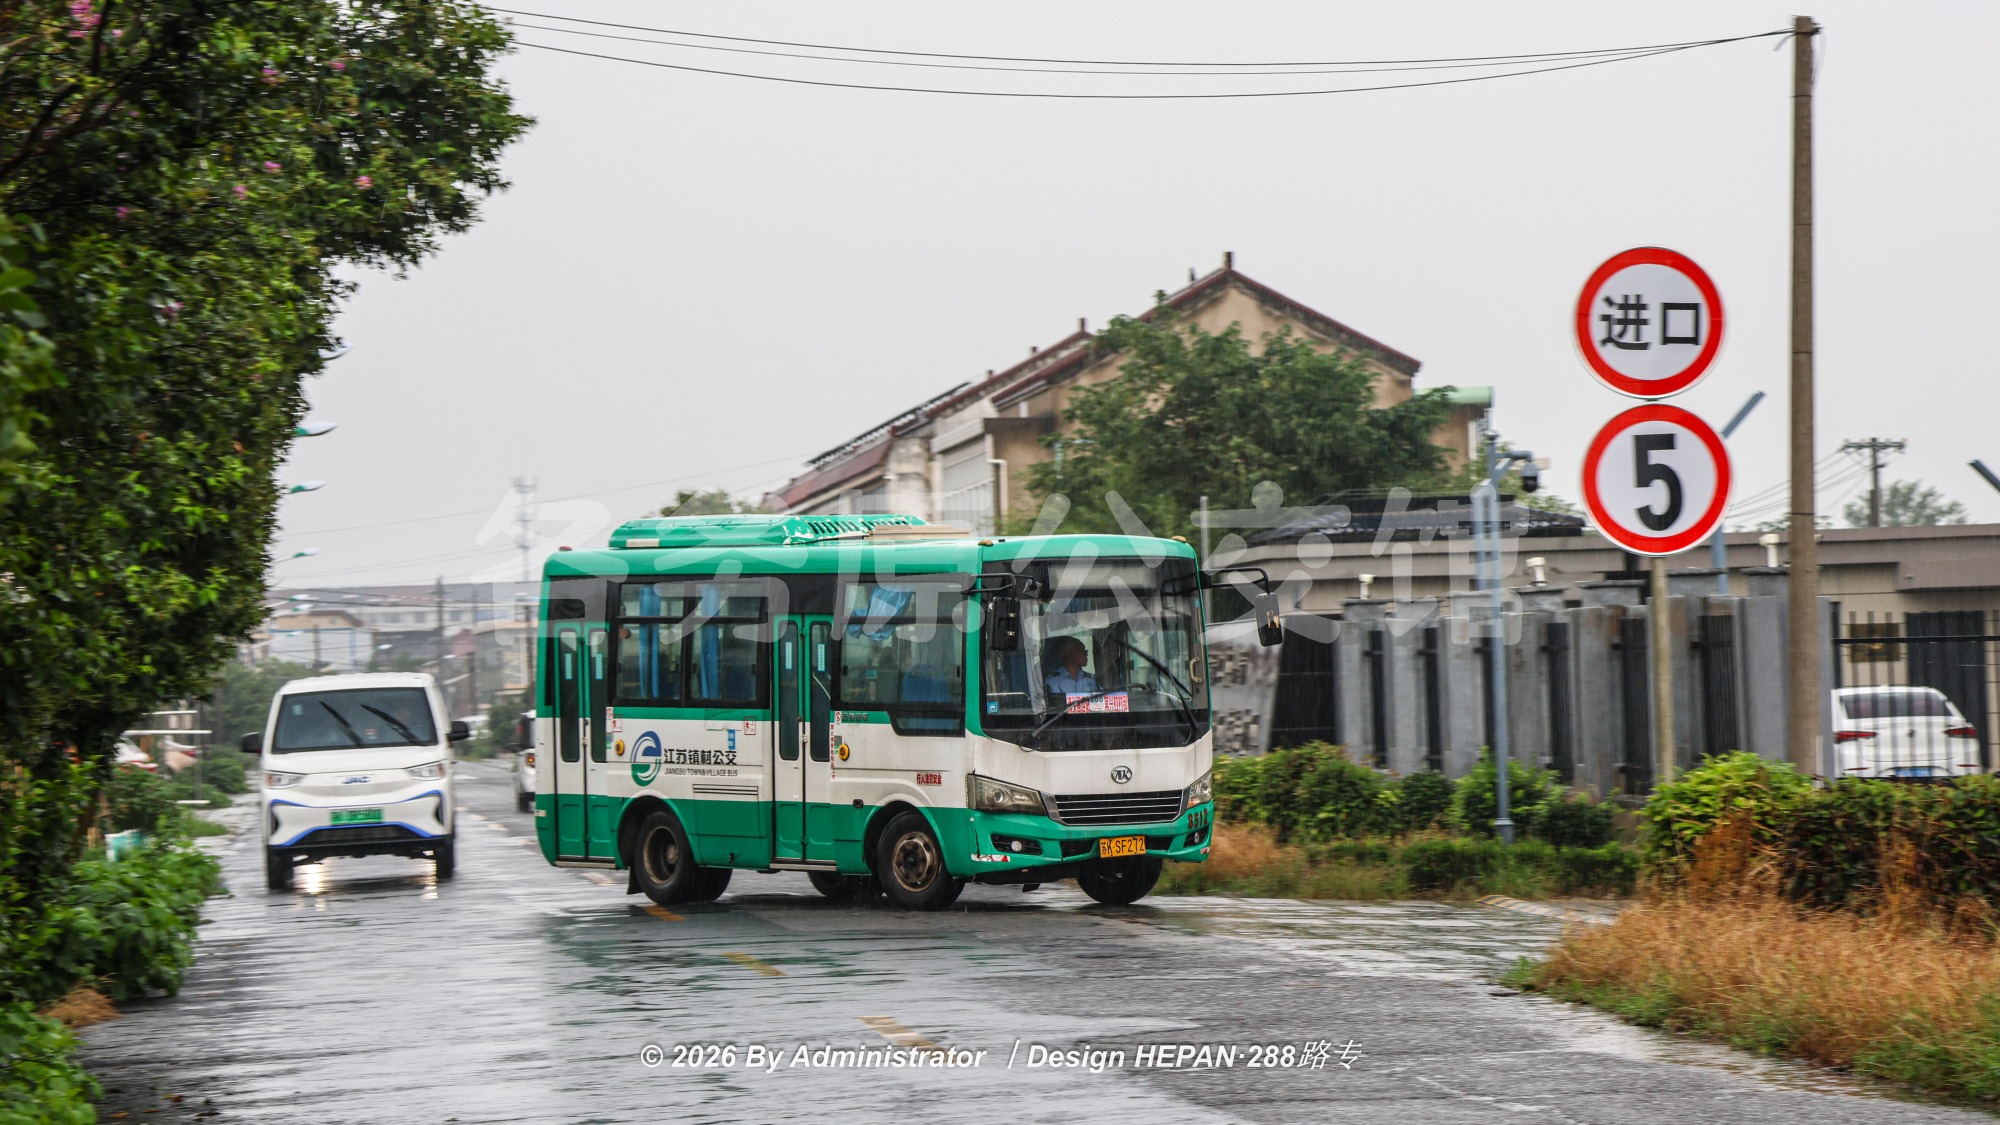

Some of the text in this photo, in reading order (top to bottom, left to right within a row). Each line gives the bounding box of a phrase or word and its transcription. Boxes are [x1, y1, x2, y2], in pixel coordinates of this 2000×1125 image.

[1599, 294, 1702, 350] 进口
[1632, 433, 1682, 532] 5
[664, 748, 737, 765] 江苏镇村公交
[664, 768, 686, 776] JIANGSU
[727, 769, 738, 777] BUS
[1187, 808, 1208, 829] 8512
